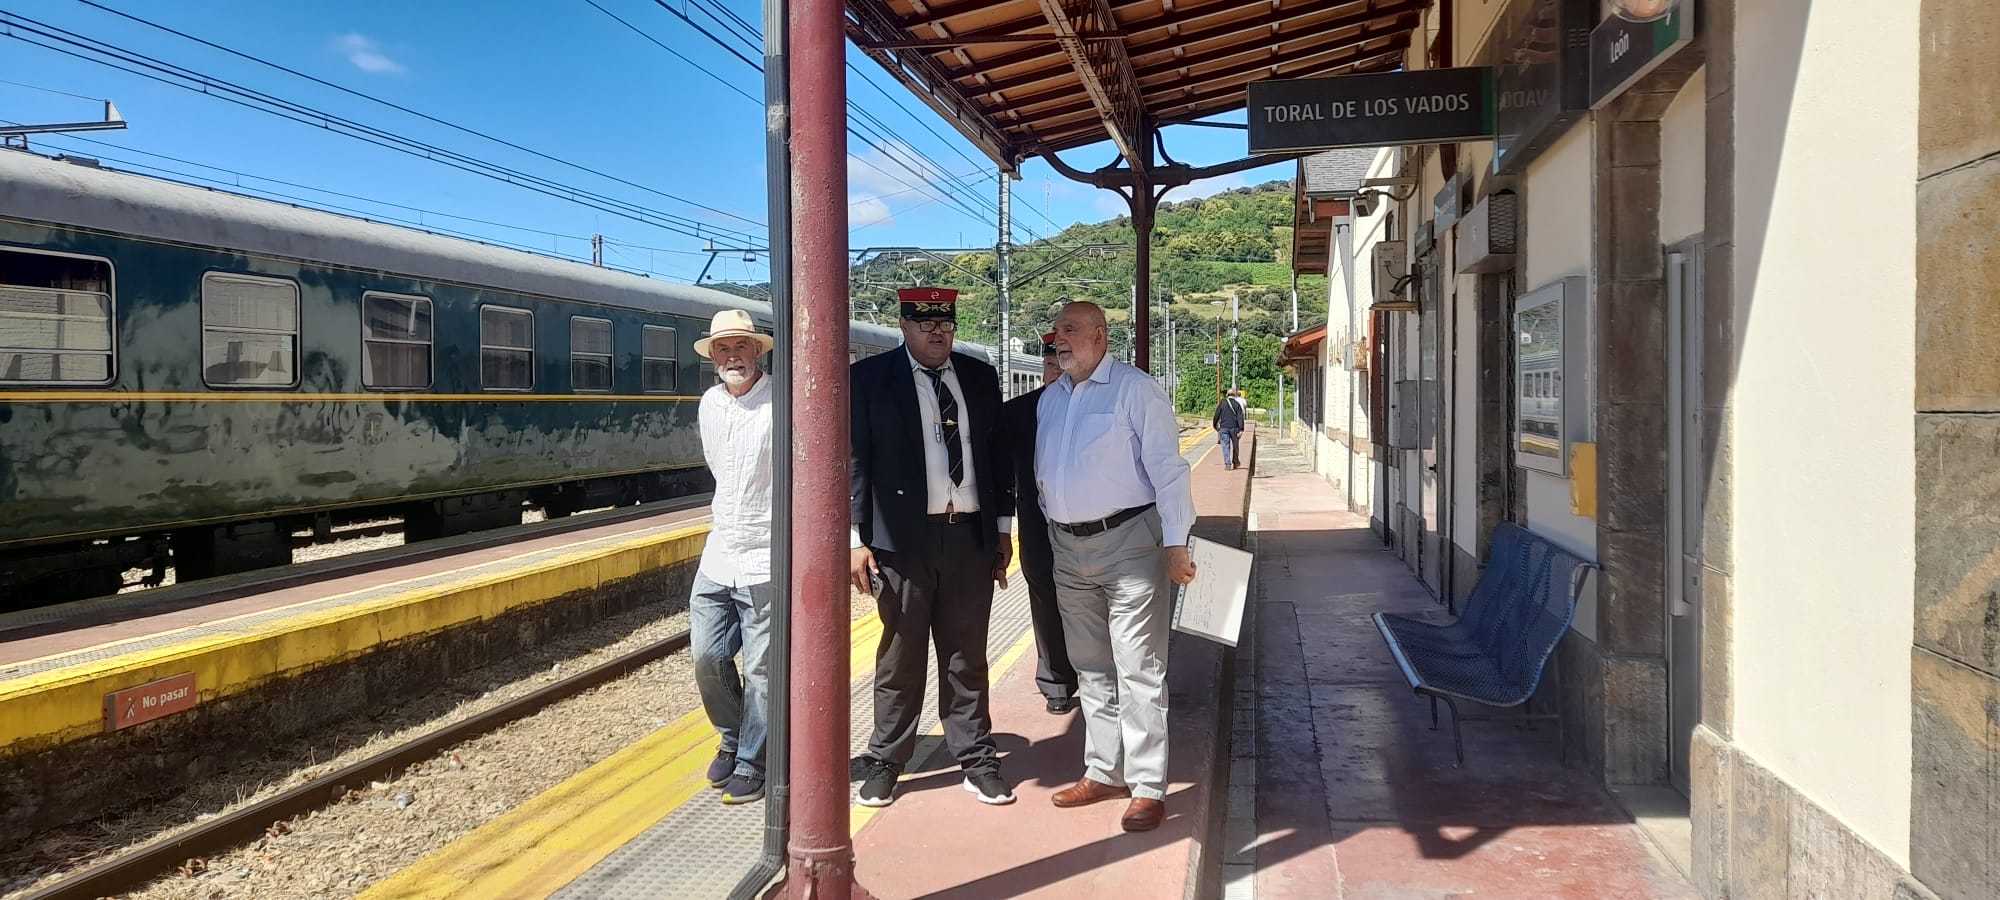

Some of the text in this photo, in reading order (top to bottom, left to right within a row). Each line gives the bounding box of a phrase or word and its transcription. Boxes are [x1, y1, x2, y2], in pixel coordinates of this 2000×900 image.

[1610, 29, 1629, 63] León
[1263, 93, 1470, 123] TORAL DE LOS VADOS
[142, 686, 189, 709] No pasar
